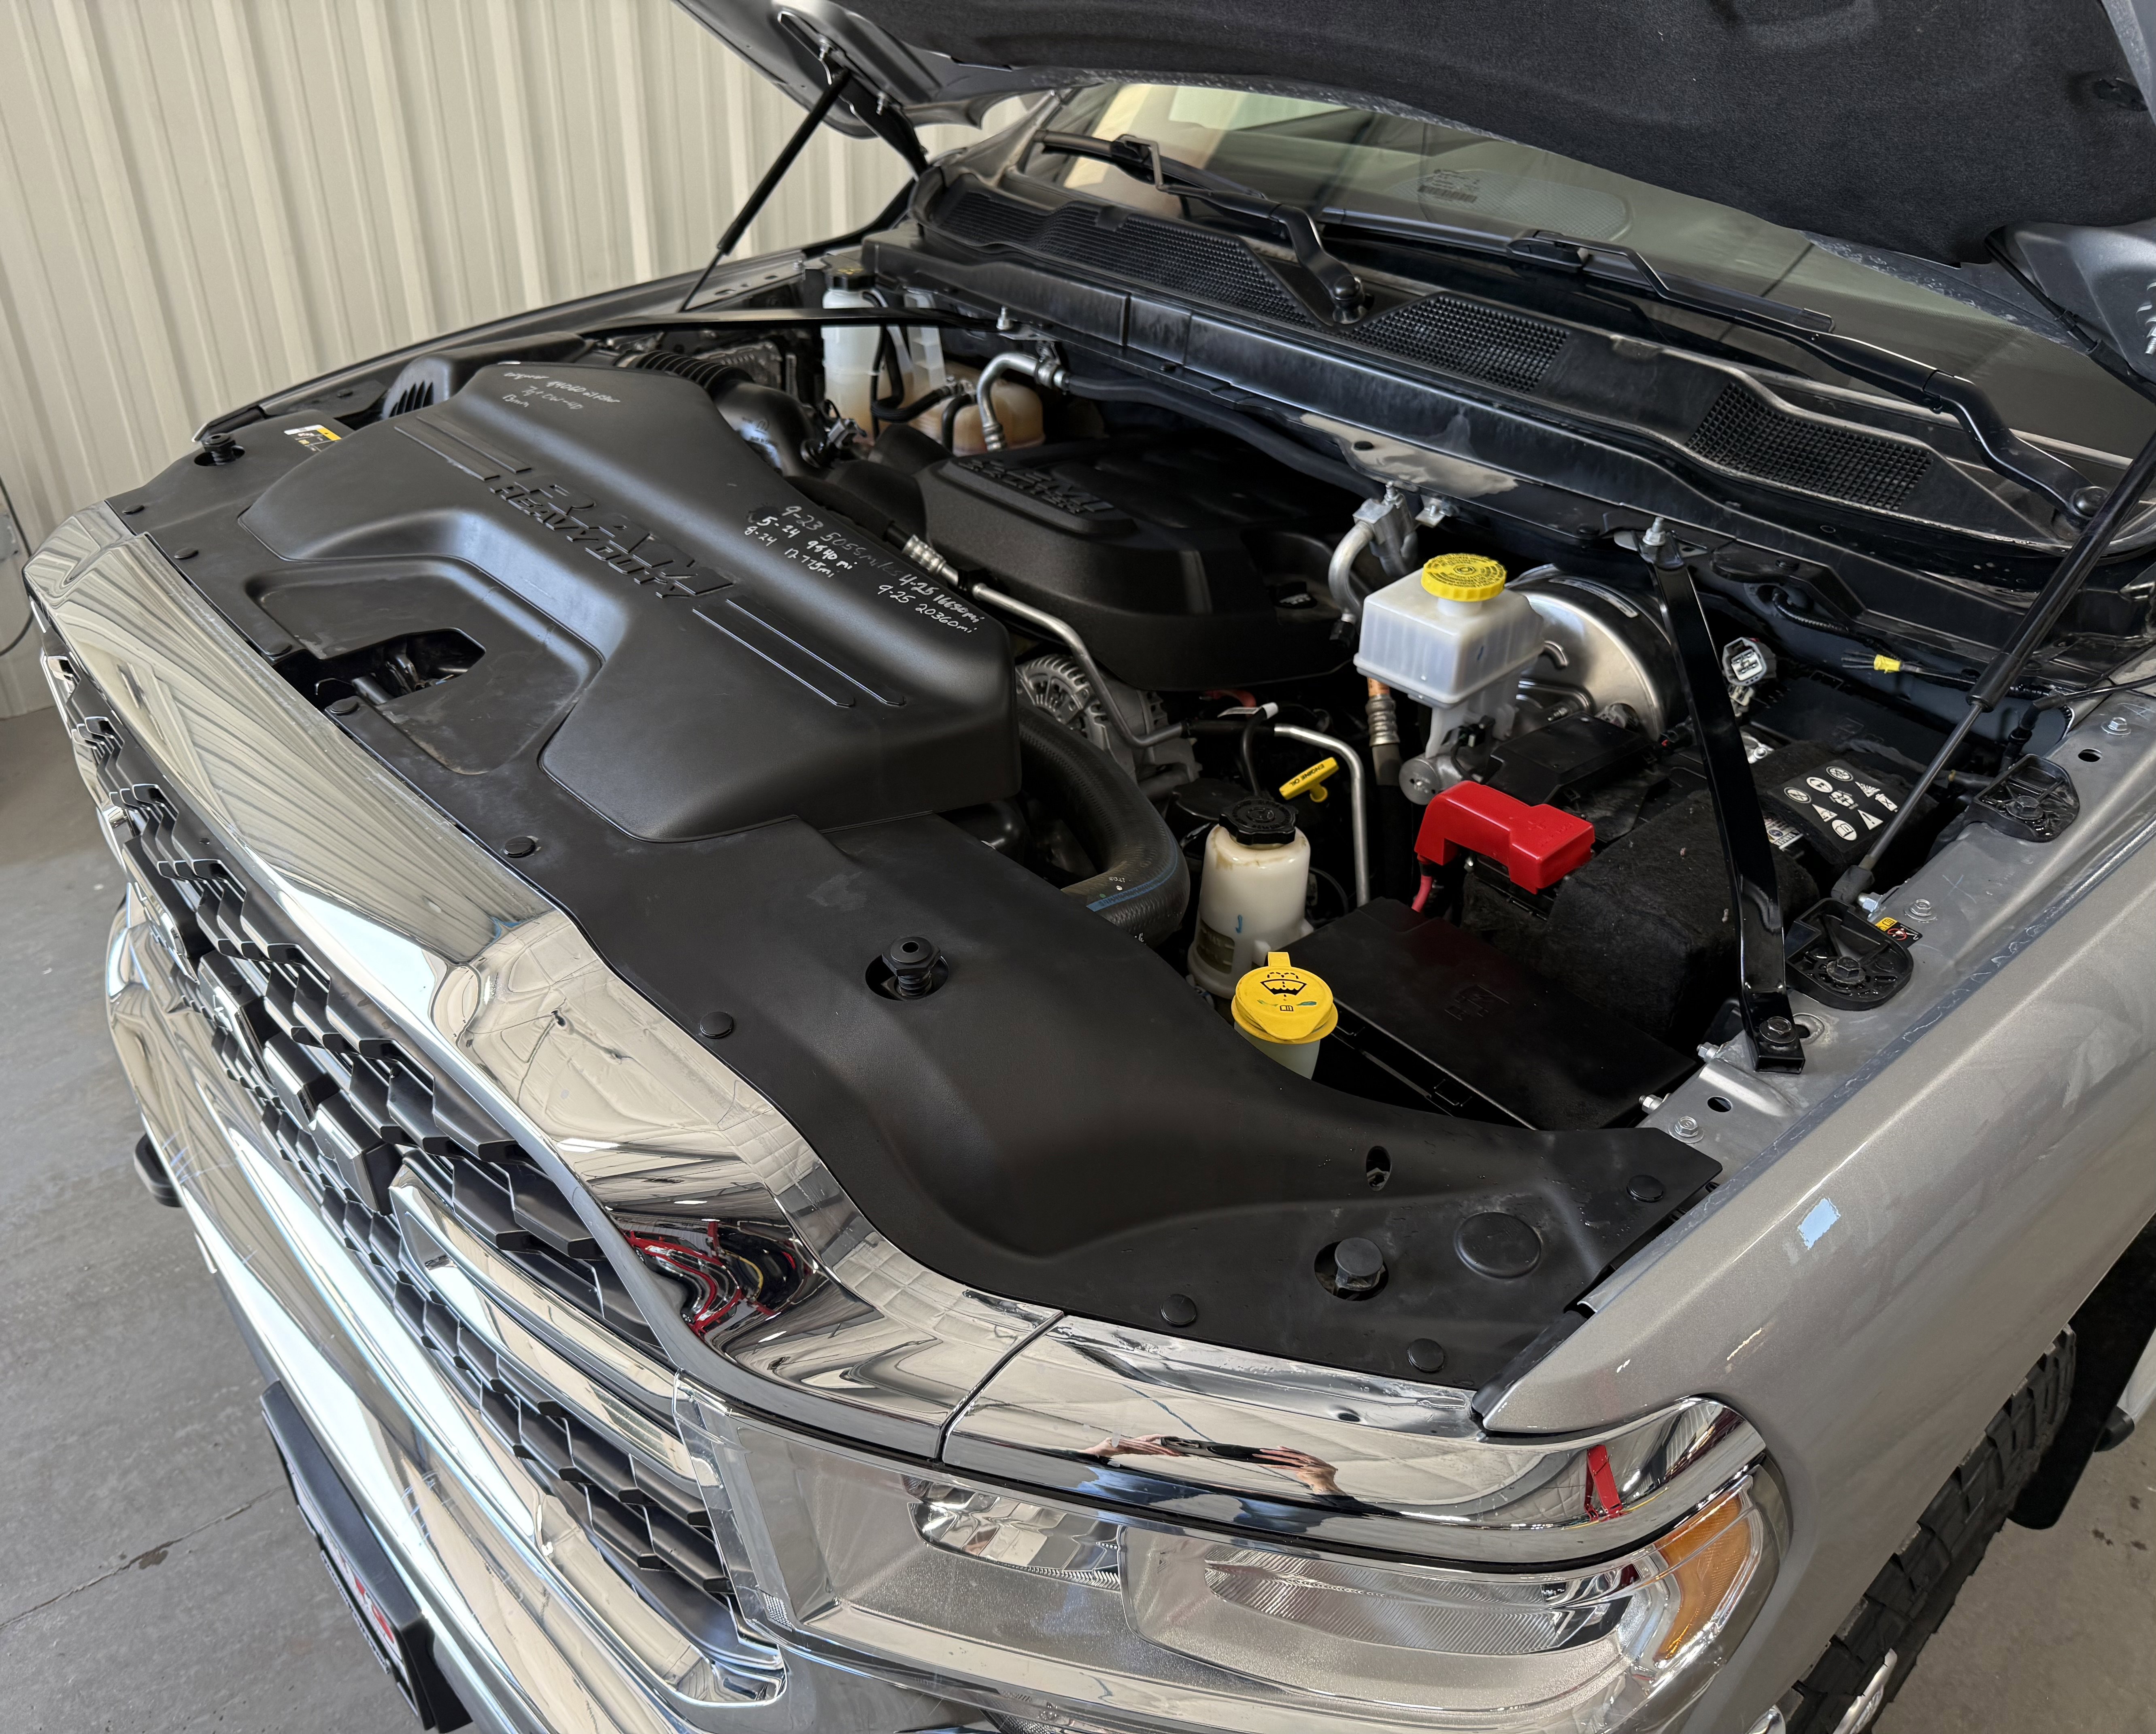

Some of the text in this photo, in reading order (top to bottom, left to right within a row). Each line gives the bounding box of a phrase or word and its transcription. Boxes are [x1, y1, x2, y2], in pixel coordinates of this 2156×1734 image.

[782, 506, 823, 530] 9-23
[490, 485, 691, 599] HEAVY DUTY
[878, 585, 916, 603] 9-25
[1289, 763, 1325, 786] ENGINE OIL
